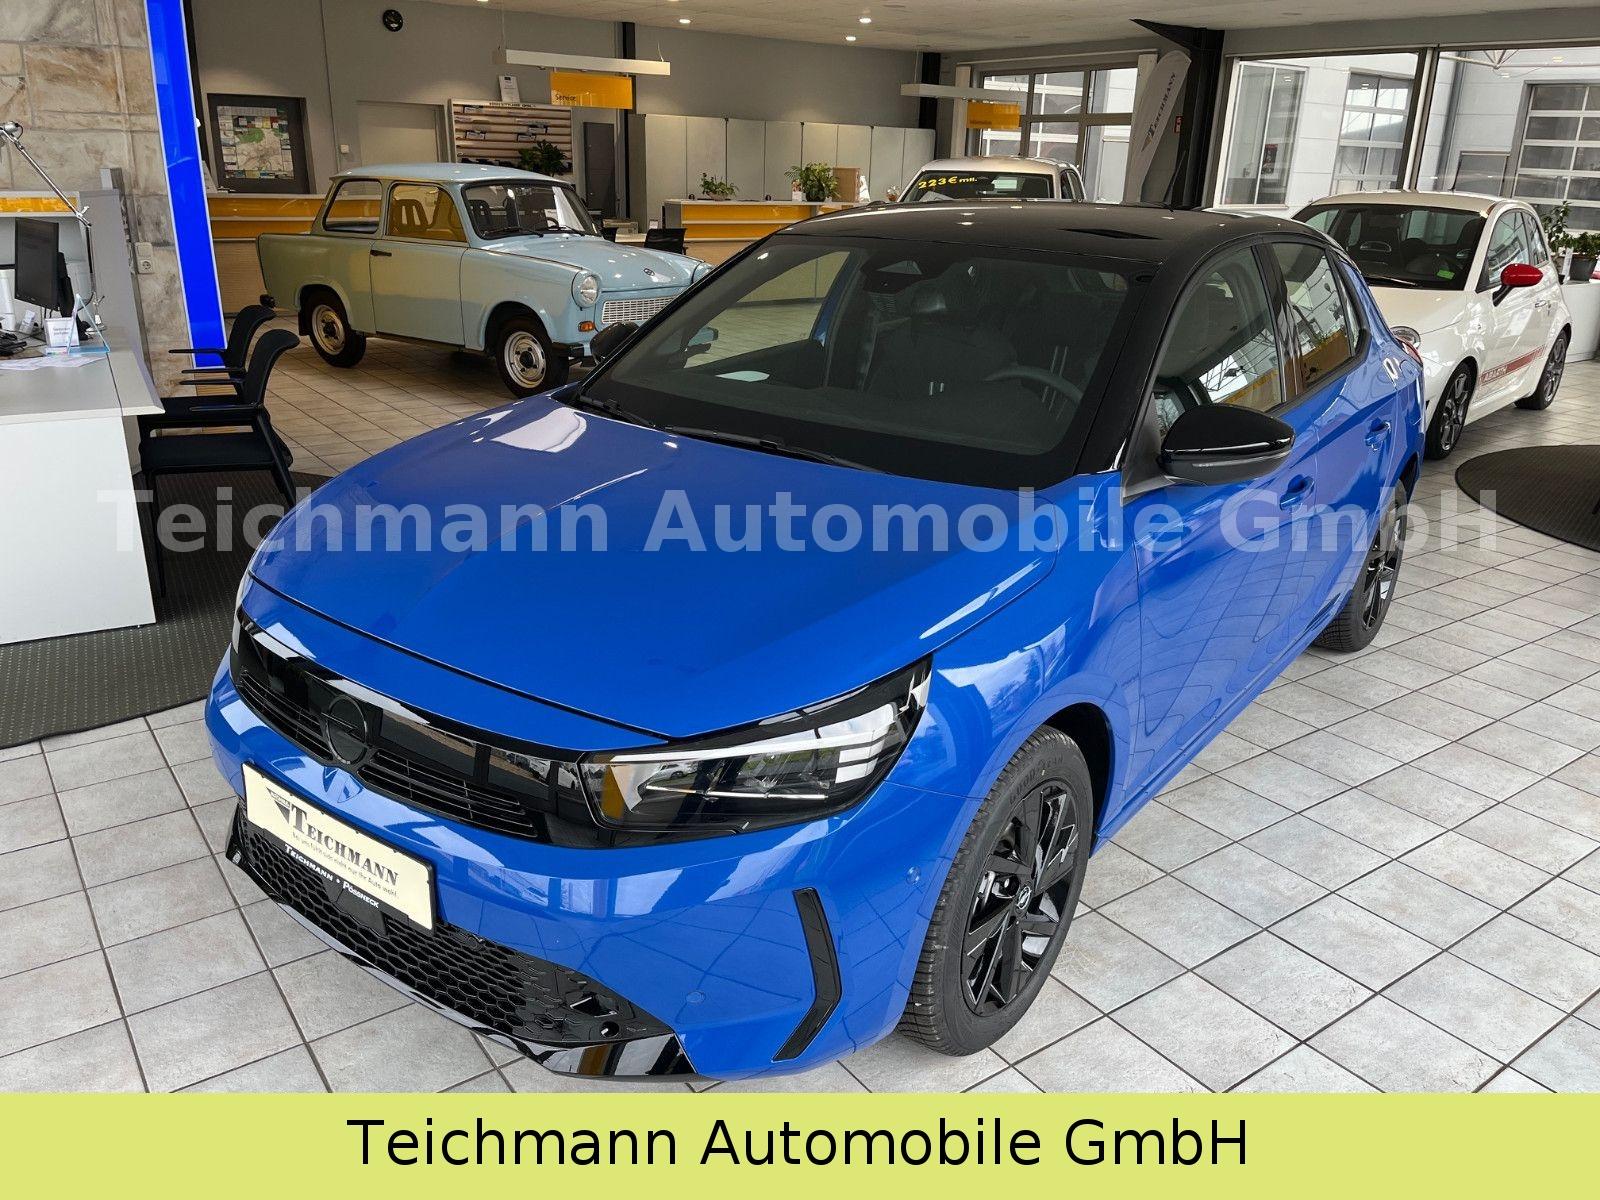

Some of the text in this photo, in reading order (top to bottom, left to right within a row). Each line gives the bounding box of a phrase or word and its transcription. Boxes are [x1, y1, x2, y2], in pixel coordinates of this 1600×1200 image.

[555, 93, 576, 102] Service
[918, 176, 958, 189] 223€
[292, 803, 398, 886] TEICHMANN
[285, 843, 333, 881] TEICHMANN
